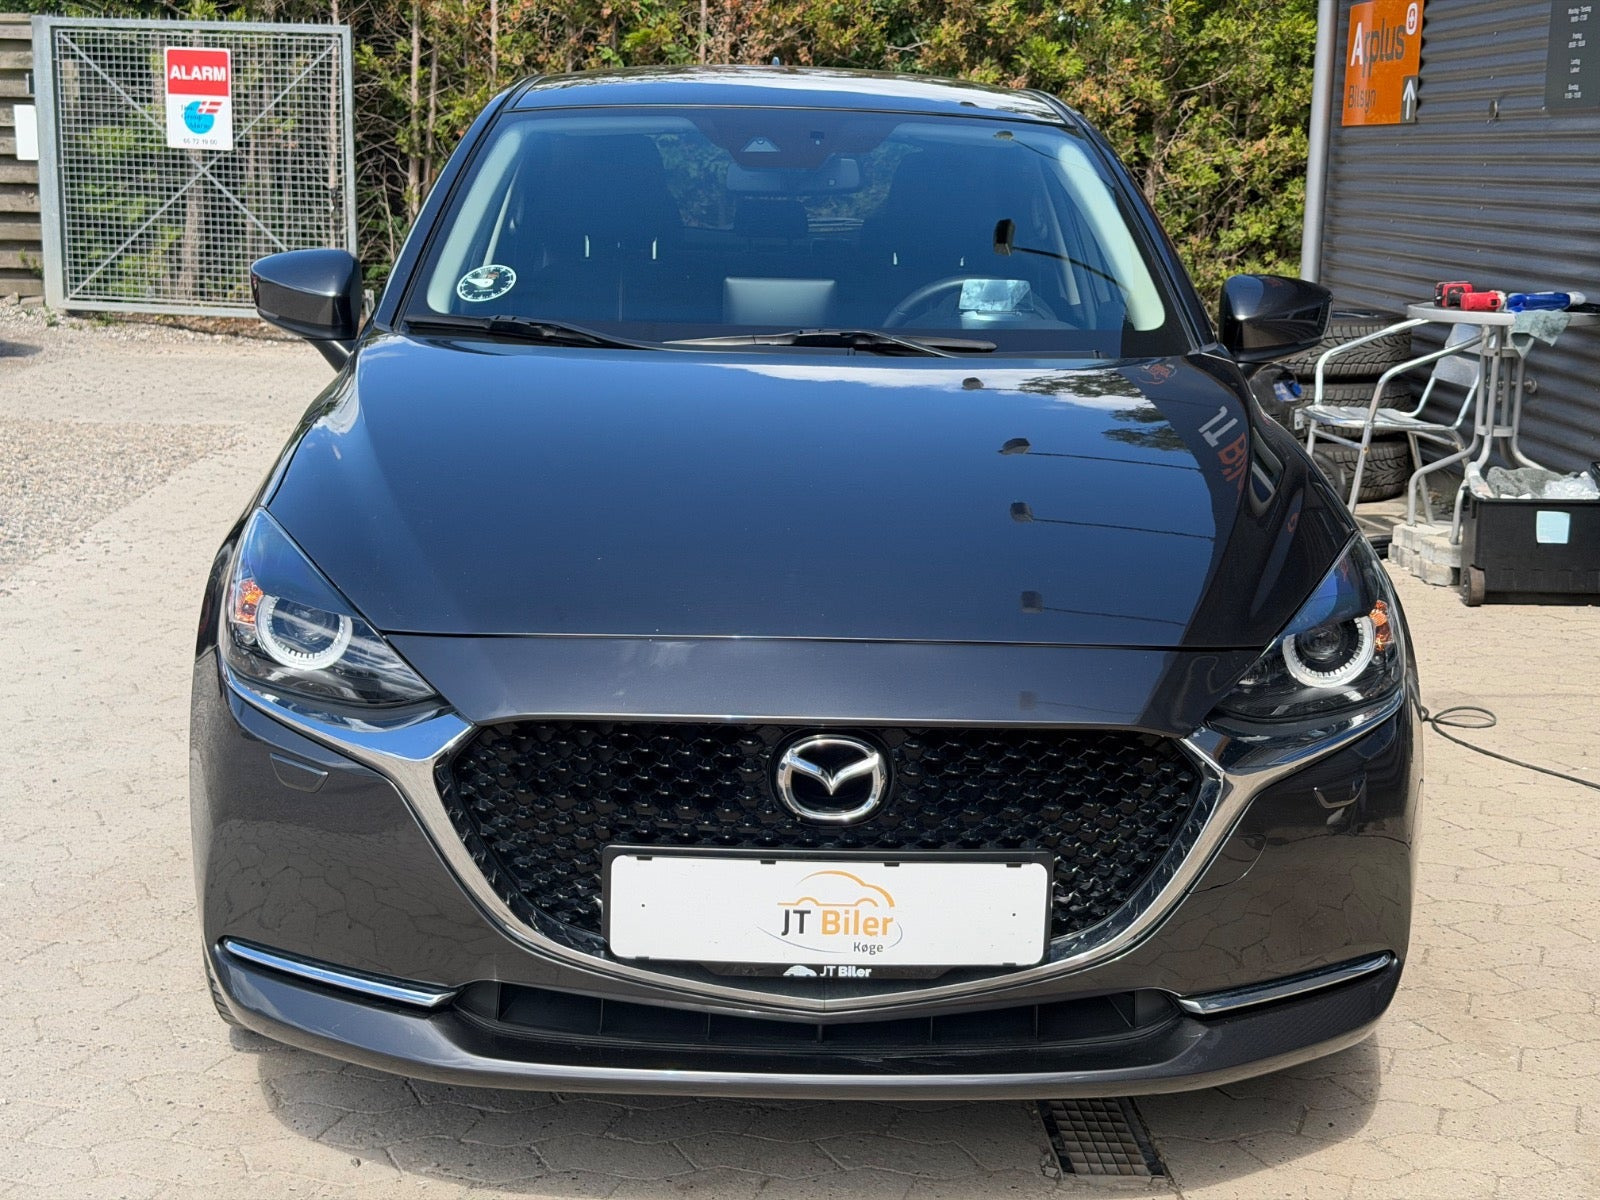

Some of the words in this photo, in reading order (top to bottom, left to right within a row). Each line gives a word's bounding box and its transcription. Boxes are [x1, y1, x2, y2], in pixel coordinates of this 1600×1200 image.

[170, 65, 227, 82] ALARM
[1348, 85, 1376, 114] Bilsyn
[781, 909, 811, 936] JT
[821, 909, 894, 936] Biler
[853, 941, 884, 955] Køge
[819, 965, 836, 977] JT
[838, 965, 872, 978] Biler
